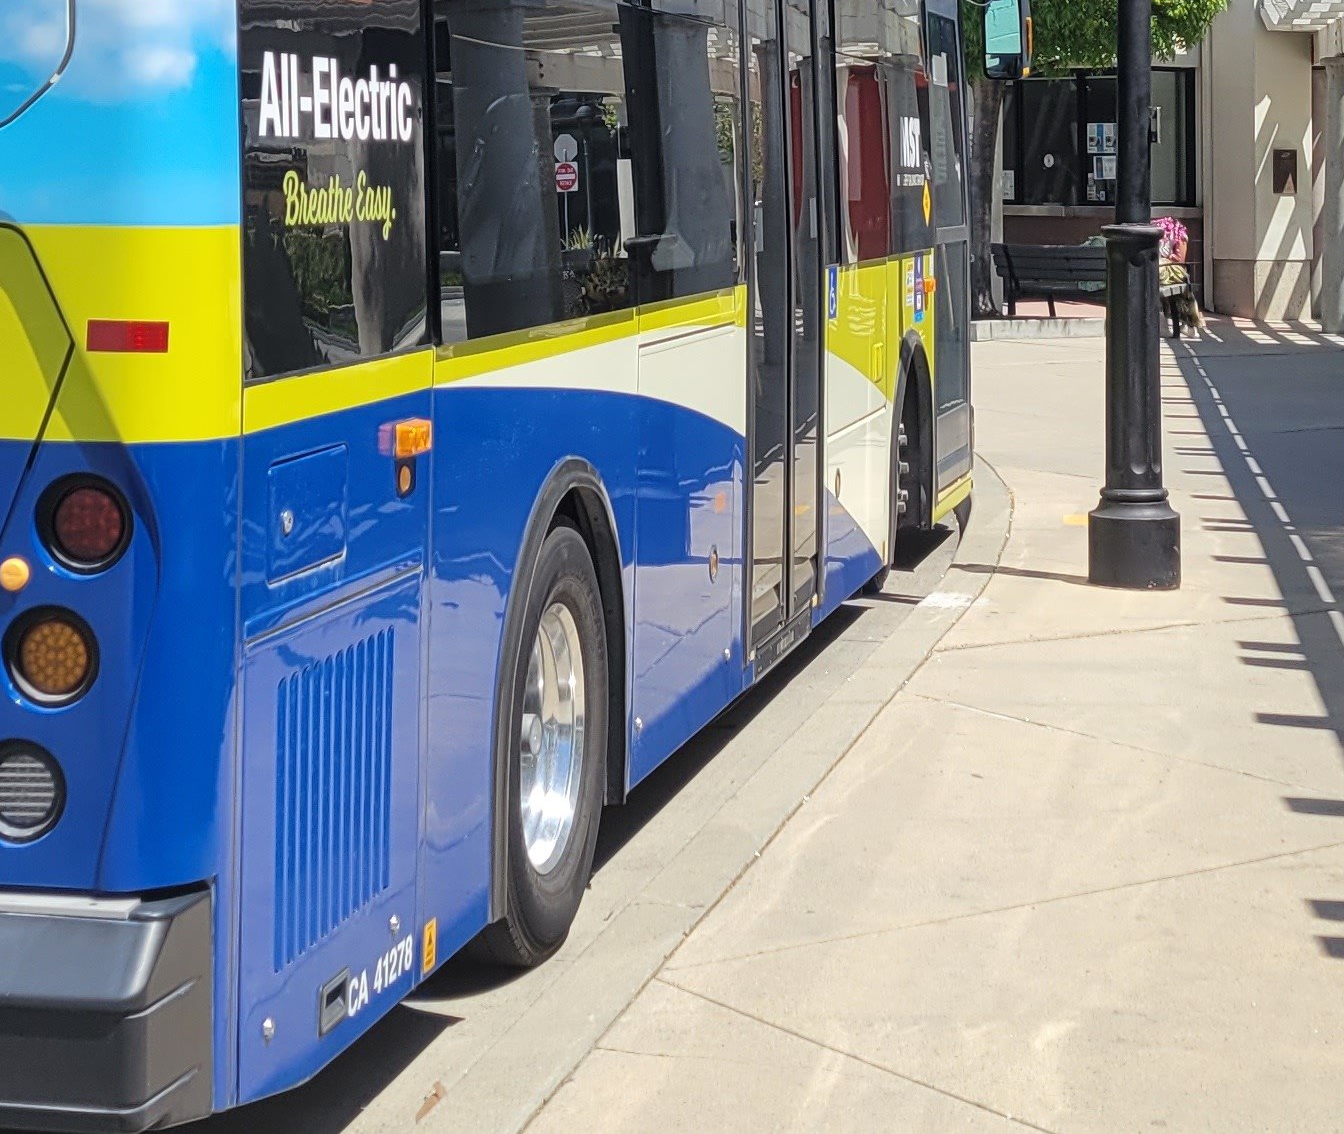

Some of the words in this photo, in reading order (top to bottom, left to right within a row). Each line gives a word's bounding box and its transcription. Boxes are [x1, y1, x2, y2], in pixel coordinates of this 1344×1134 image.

[258, 50, 413, 141] All-Electric
[899, 116, 921, 168] MST
[283, 170, 353, 226] Breathe
[356, 169, 397, 241] Easy.
[347, 968, 369, 1017] CA
[373, 933, 413, 994] 41278
